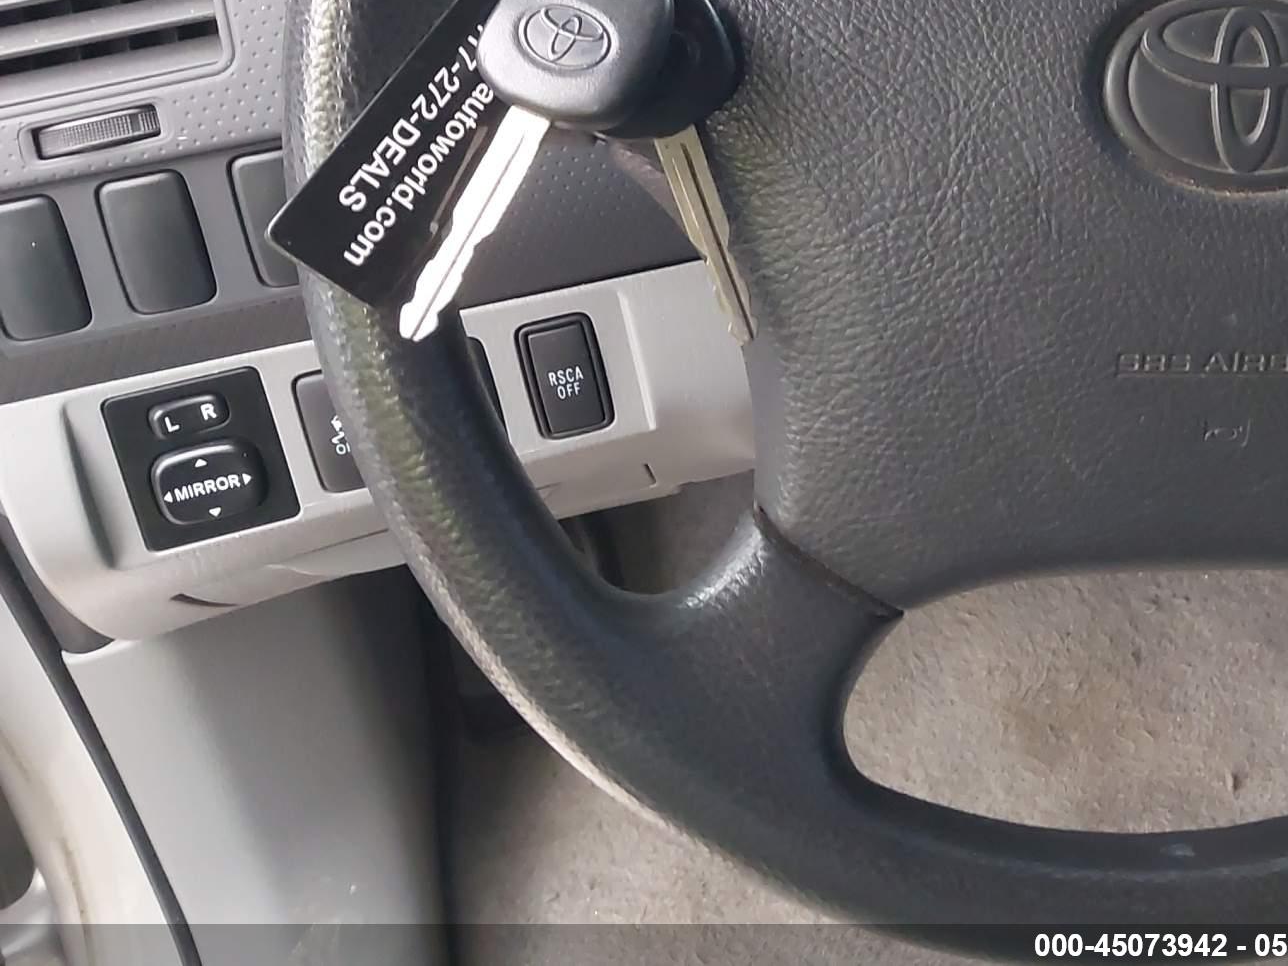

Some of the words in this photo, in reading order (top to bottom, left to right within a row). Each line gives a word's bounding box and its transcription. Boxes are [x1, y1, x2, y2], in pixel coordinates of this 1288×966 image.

[1118, 352, 1191, 373] SRS
[548, 365, 584, 387] RSCA
[557, 382, 580, 399] OFF
[164, 416, 180, 432] L
[200, 403, 217, 420] R
[174, 474, 241, 502] MIRROR
